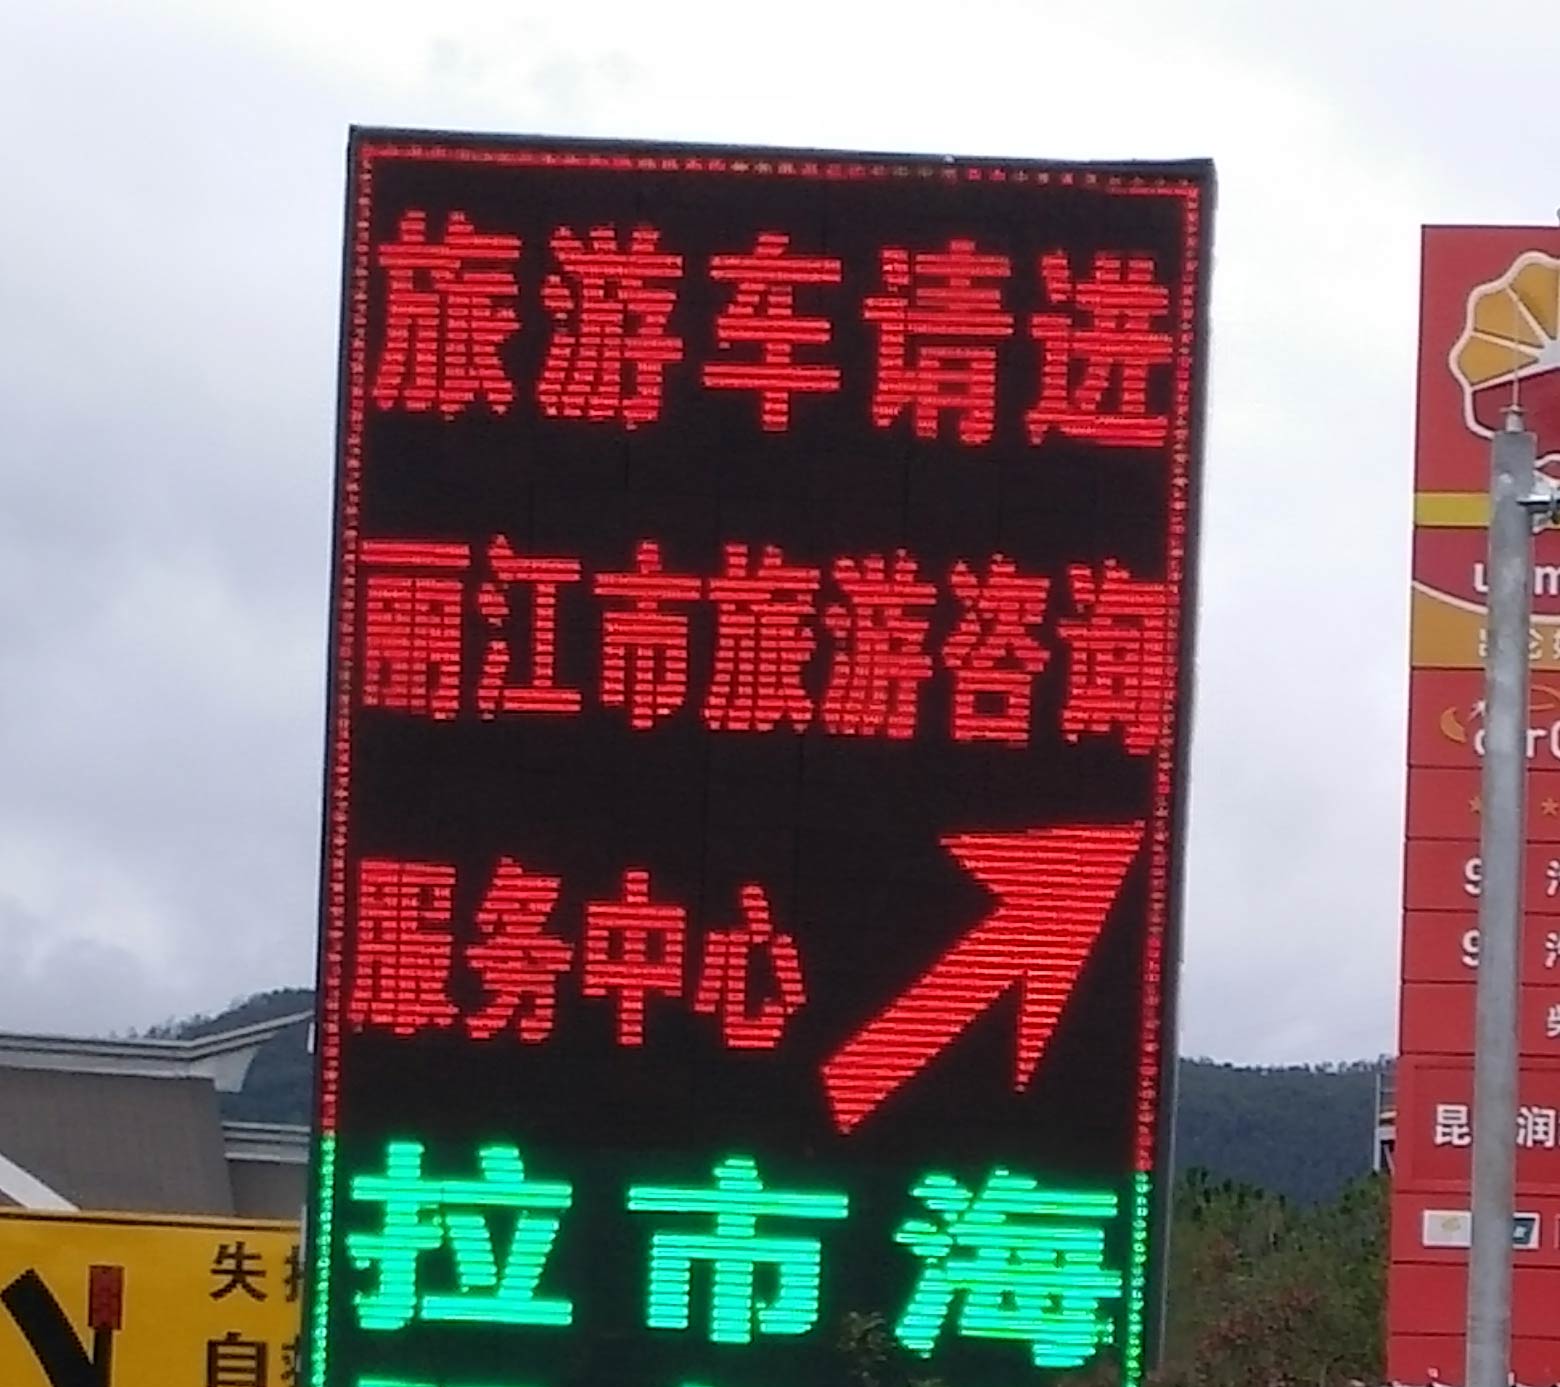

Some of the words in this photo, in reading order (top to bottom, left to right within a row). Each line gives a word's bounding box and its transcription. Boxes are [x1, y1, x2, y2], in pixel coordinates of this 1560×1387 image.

[372, 210, 1174, 448] 旅游车请进
[358, 535, 1166, 756] 丽江市旅游咨询
[347, 857, 806, 1050] 服务中心
[345, 1140, 1123, 1368] 拉市海
